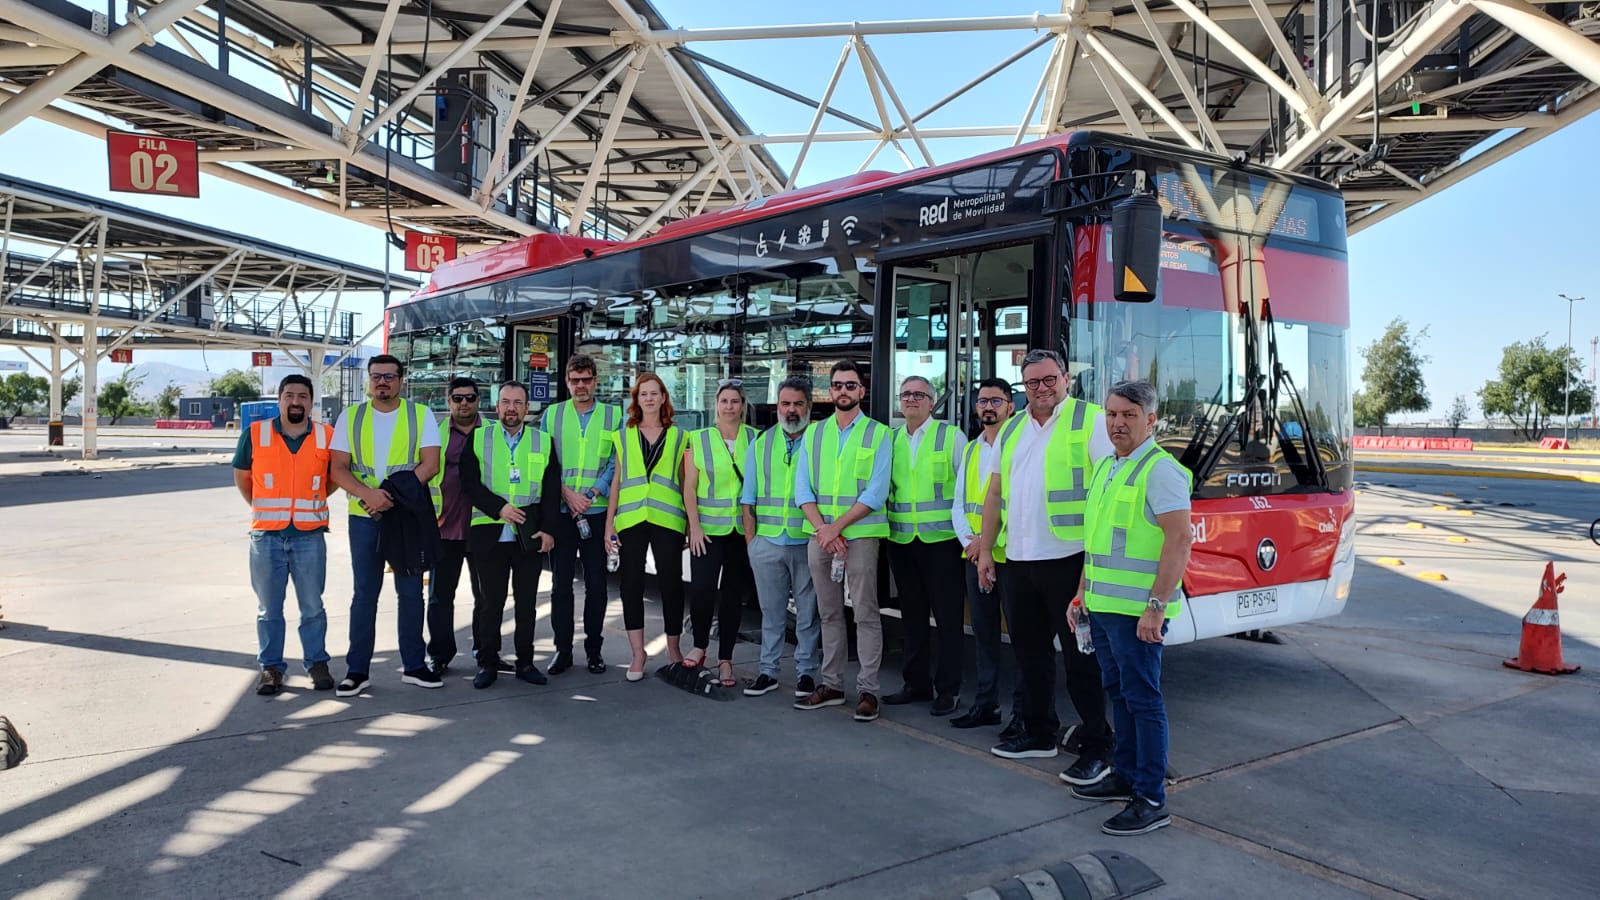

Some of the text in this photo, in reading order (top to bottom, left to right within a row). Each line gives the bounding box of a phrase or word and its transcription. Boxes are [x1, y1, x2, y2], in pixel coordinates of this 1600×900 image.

[138, 138, 167, 151] FILA
[129, 150, 179, 193] 02
[953, 191, 1006, 209] Metropolitana
[919, 196, 949, 227] Red
[952, 201, 1005, 221] de Movilidad
[422, 235, 440, 244] FILA
[416, 243, 445, 270] 03
[1226, 472, 1282, 487] FOTON
[1248, 496, 1272, 509] 162
